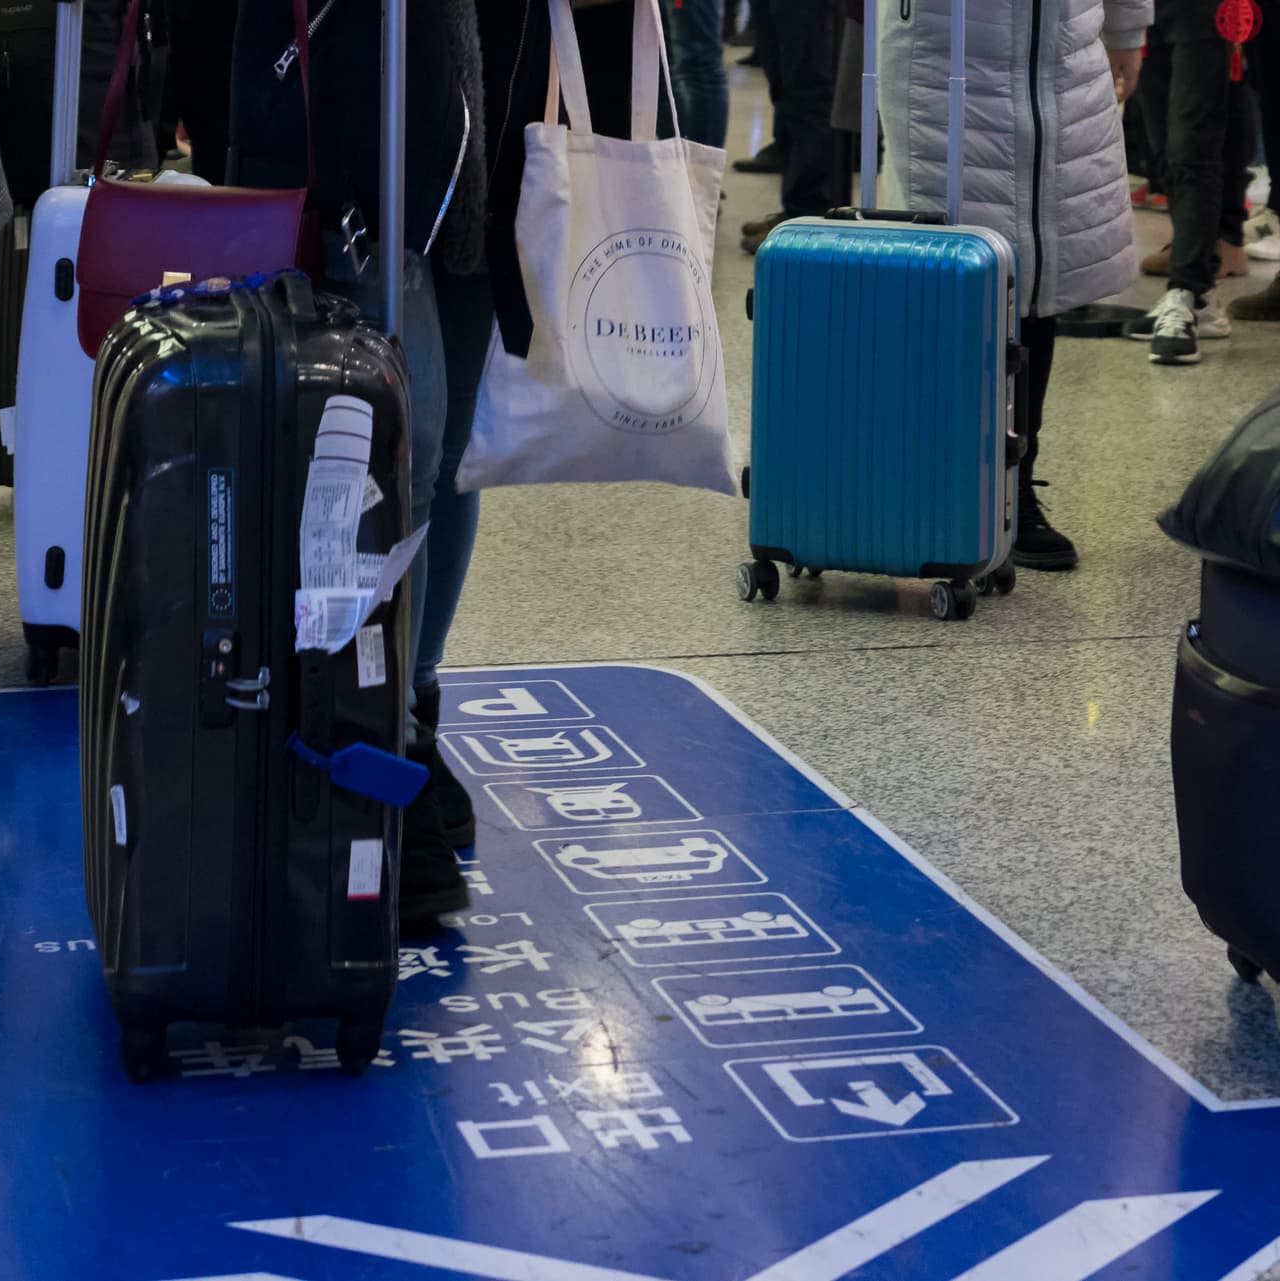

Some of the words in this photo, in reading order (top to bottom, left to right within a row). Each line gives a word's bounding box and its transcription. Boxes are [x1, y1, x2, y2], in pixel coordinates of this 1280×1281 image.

[582, 258, 603, 282] THE
[638, 236, 655, 247] OF
[661, 238, 702, 285] DIAMNDS
[613, 410, 646, 429] SINCE
[34, 939, 96, 953] us
[439, 988, 593, 1013] Bus
[488, 1072, 664, 1106] Exit
[457, 1106, 693, 1159] 出口
